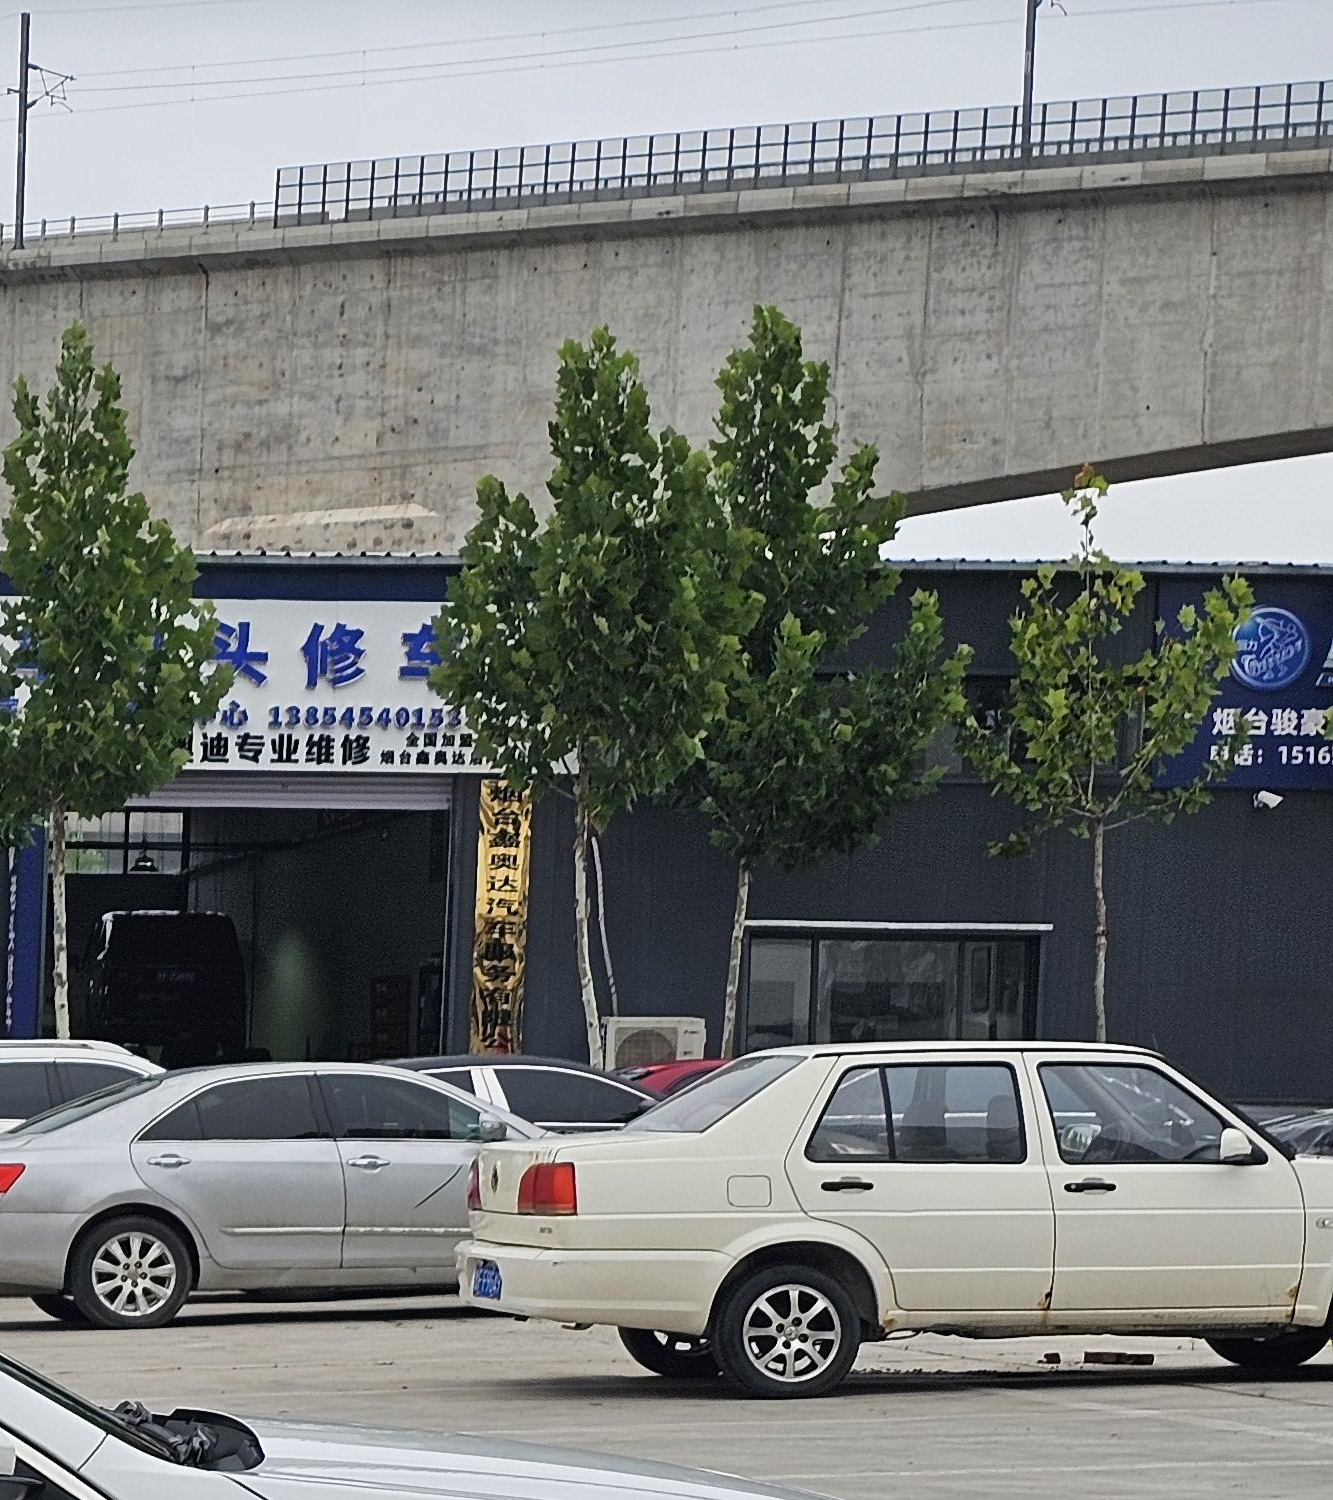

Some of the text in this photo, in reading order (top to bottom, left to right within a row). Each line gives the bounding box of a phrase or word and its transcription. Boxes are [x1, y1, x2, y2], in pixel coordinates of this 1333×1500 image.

[185, 731, 371, 765] 迪专业维修
[1278, 745, 1333, 765] 1516
